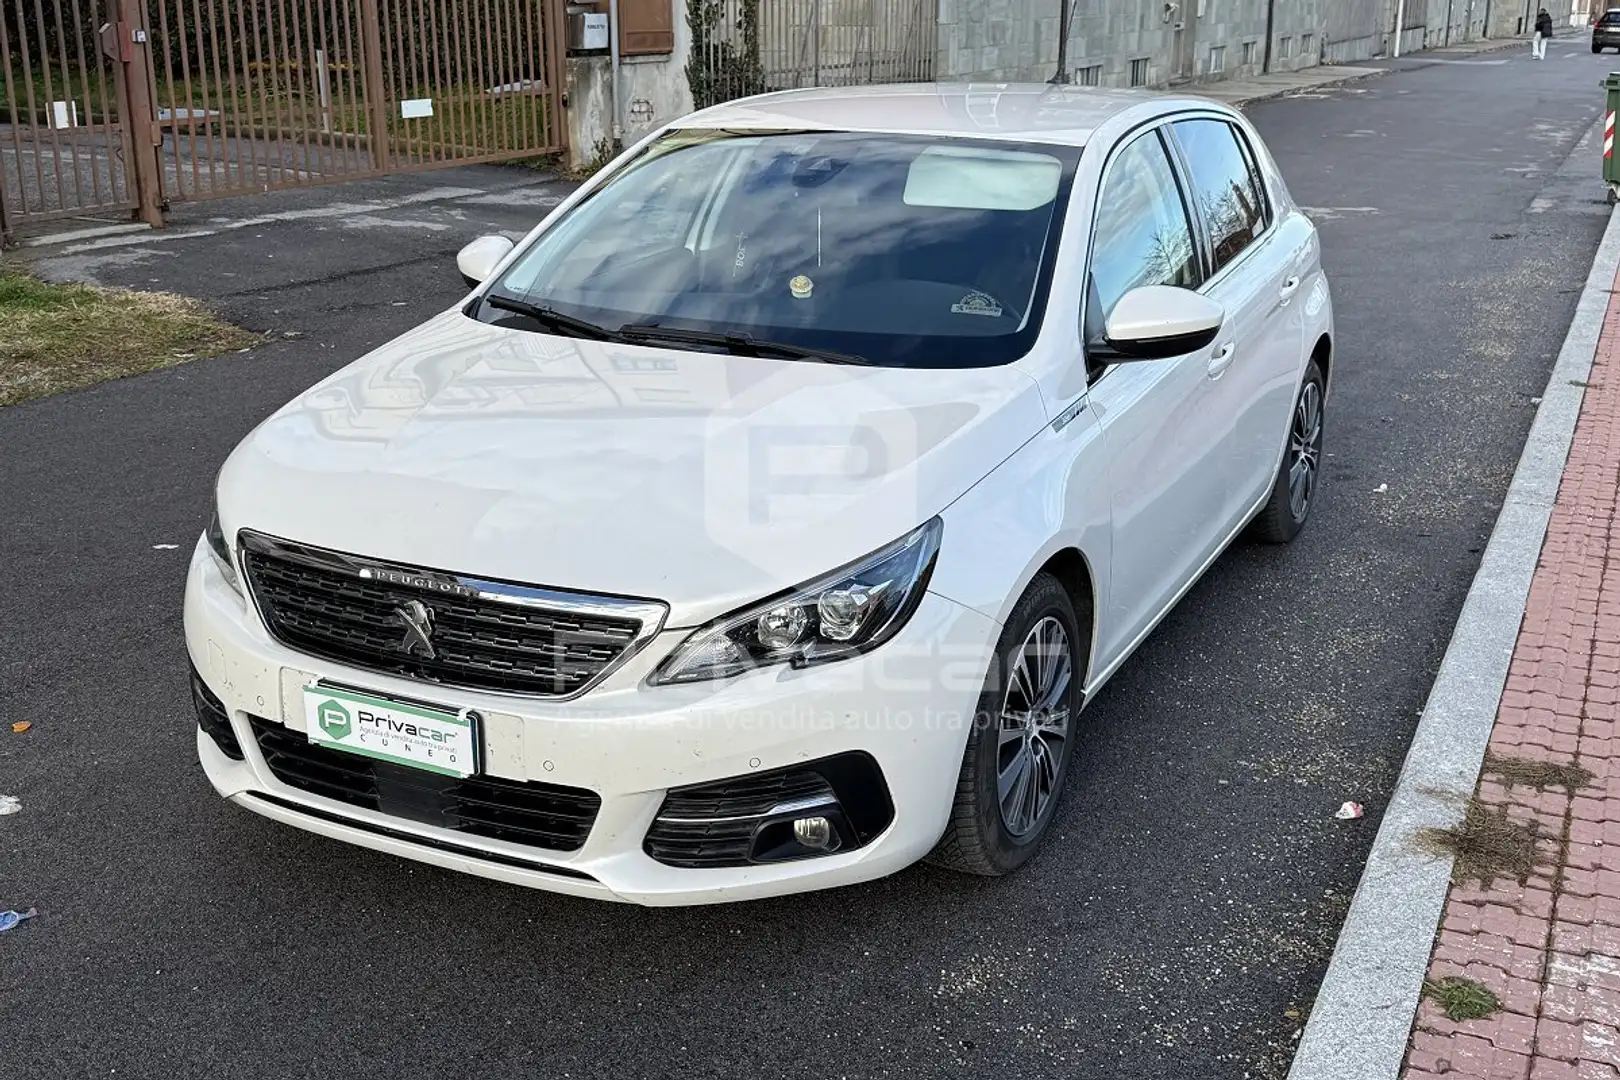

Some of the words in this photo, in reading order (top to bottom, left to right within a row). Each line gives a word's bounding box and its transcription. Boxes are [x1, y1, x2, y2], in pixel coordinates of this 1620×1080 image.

[376, 571, 461, 594] PEUGEOT
[358, 710, 456, 744] Privacar
[391, 733, 413, 744] vendita
[360, 734, 457, 763] CUNEO
